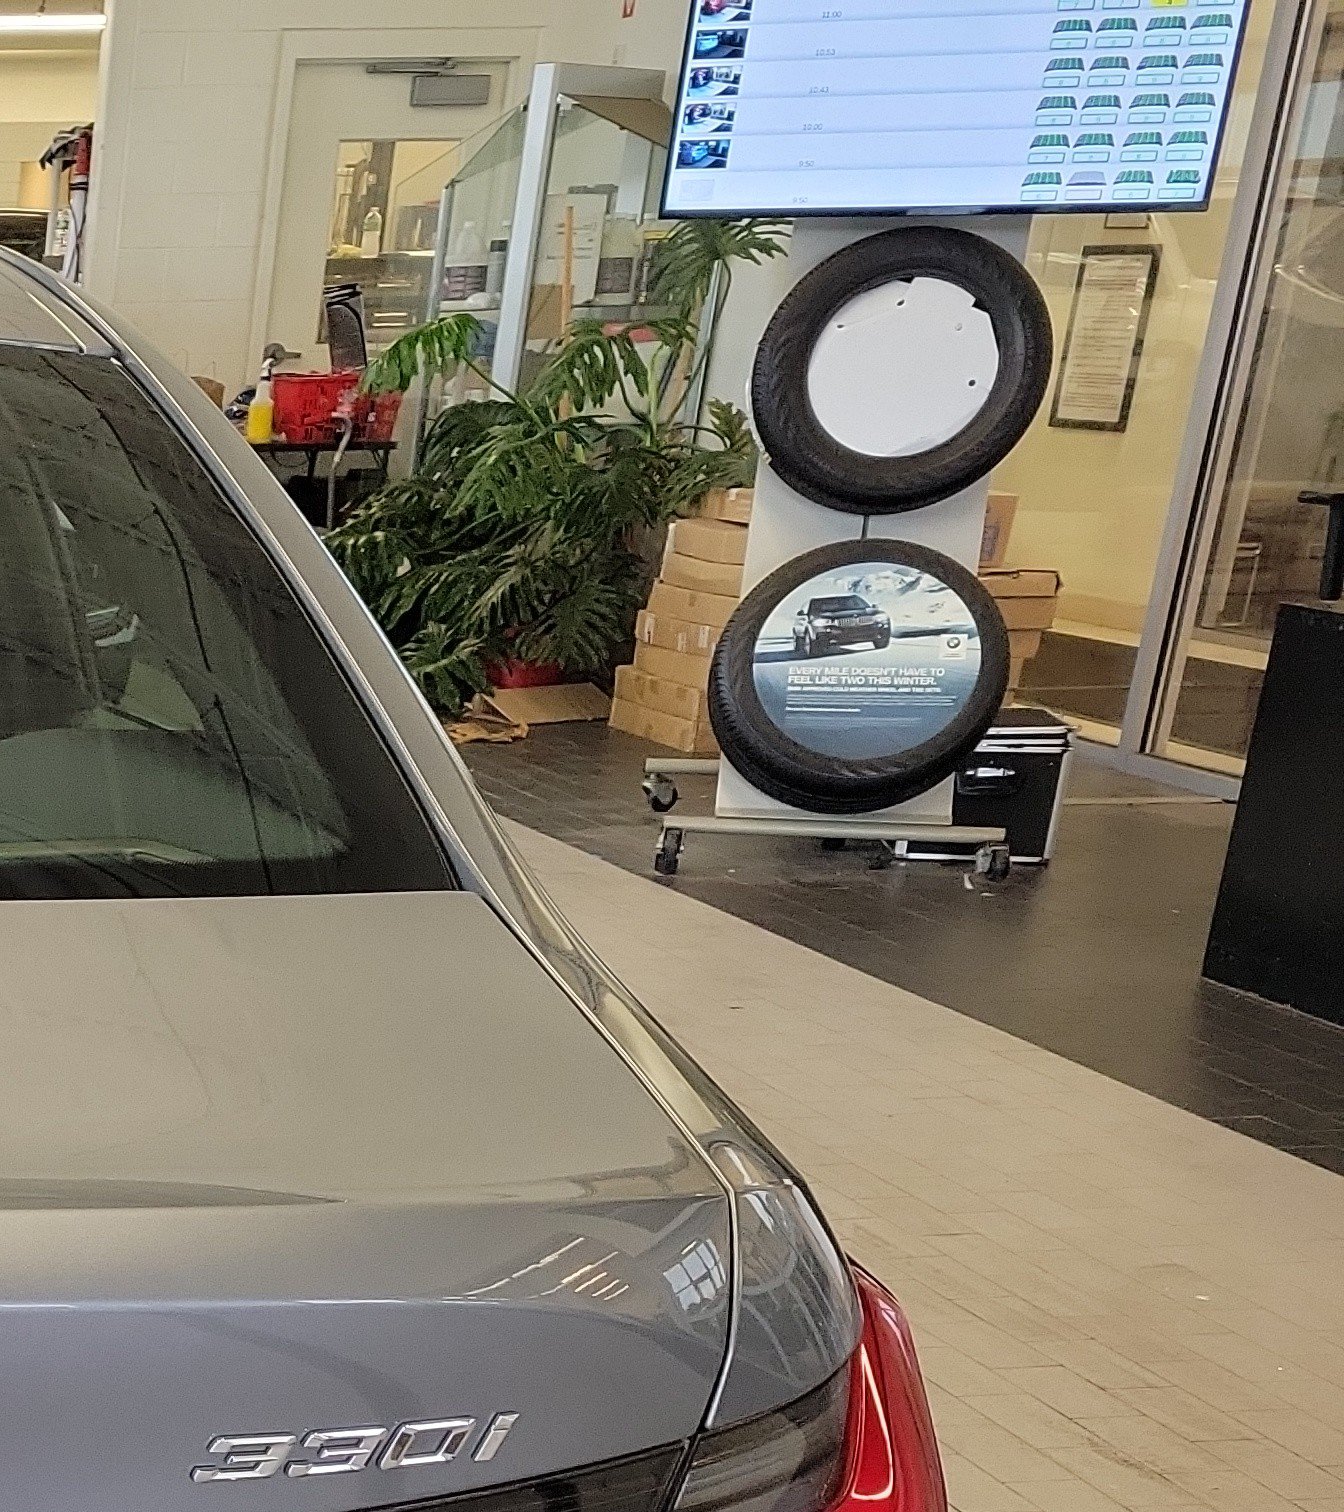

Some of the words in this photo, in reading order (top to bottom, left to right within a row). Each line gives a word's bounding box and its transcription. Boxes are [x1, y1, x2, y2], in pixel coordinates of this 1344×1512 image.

[789, 666, 823, 676] EVERY
[825, 667, 849, 676] MILE
[851, 667, 898, 676] DOESN'T
[899, 667, 927, 676] HAVE
[930, 667, 946, 677] TO
[788, 675, 814, 685] FEEL
[815, 676, 838, 685] LIKE
[840, 676, 865, 685] TWO
[868, 676, 892, 685] THIS
[893, 676, 937, 686] WINTER.
